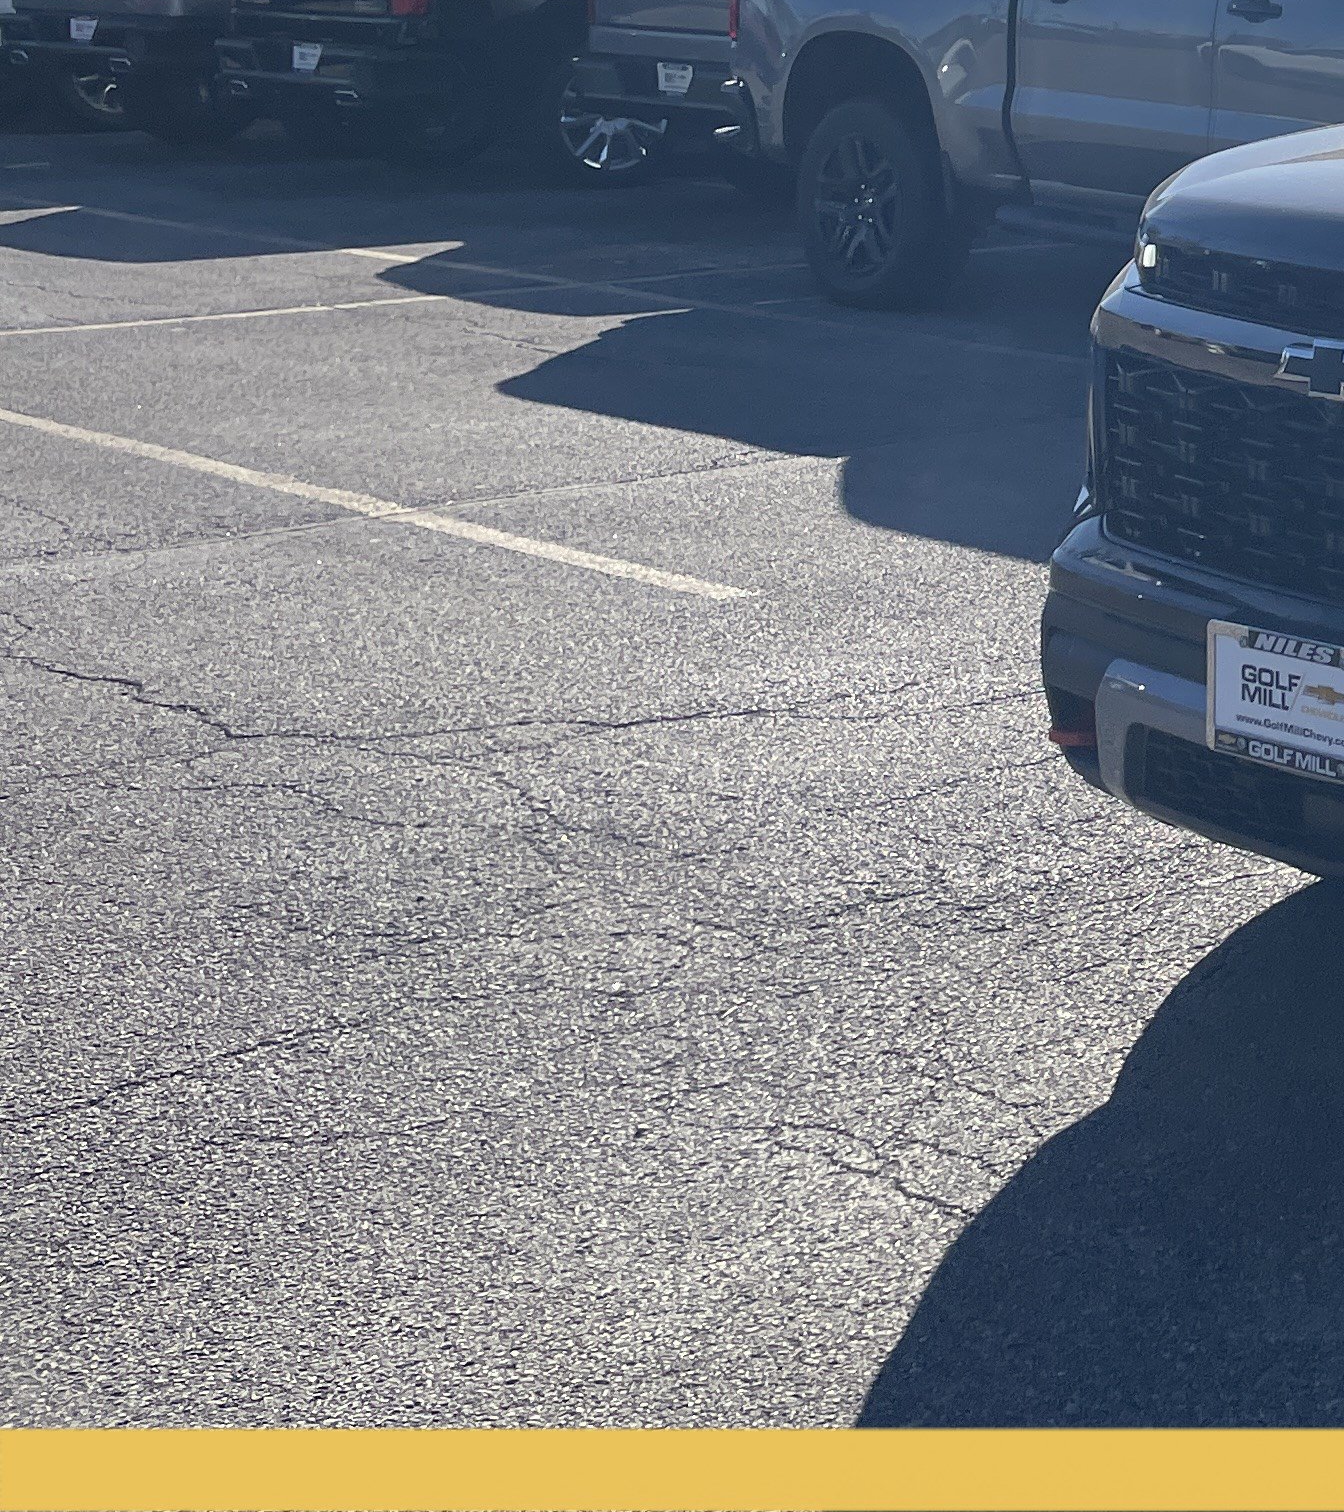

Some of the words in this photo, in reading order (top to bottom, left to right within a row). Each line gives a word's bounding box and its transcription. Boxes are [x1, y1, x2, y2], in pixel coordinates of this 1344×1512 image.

[1254, 633, 1335, 664] NILES
[1241, 664, 1301, 692] GOLF
[1241, 683, 1290, 711] MILL
[1248, 740, 1294, 762] GOLF
[1295, 751, 1337, 777] MILL
